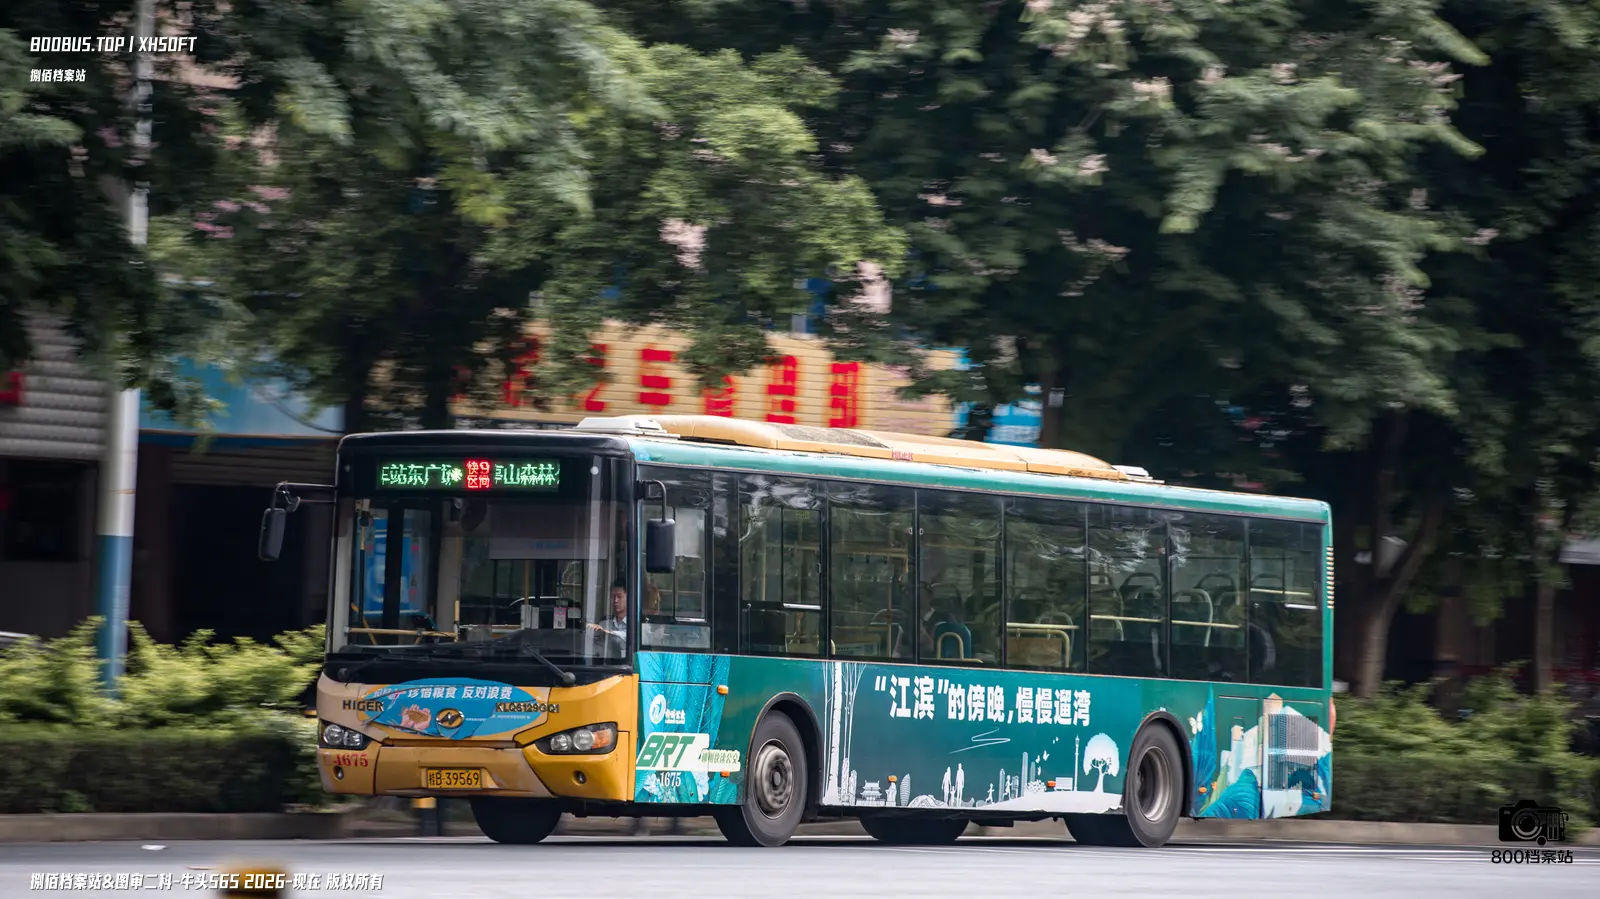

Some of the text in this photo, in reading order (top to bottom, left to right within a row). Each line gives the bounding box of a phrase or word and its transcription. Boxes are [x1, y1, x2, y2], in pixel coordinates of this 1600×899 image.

[466, 460, 490, 475] 快9
[494, 463, 560, 486] 山森林
[467, 475, 490, 489] 区间
[407, 686, 457, 699] 珍惜粮食
[461, 686, 513, 700] 反对浪费
[342, 699, 384, 712] HIGER
[636, 735, 696, 768] BRT
[333, 752, 369, 768] 1675
[660, 772, 682, 787] 1675
